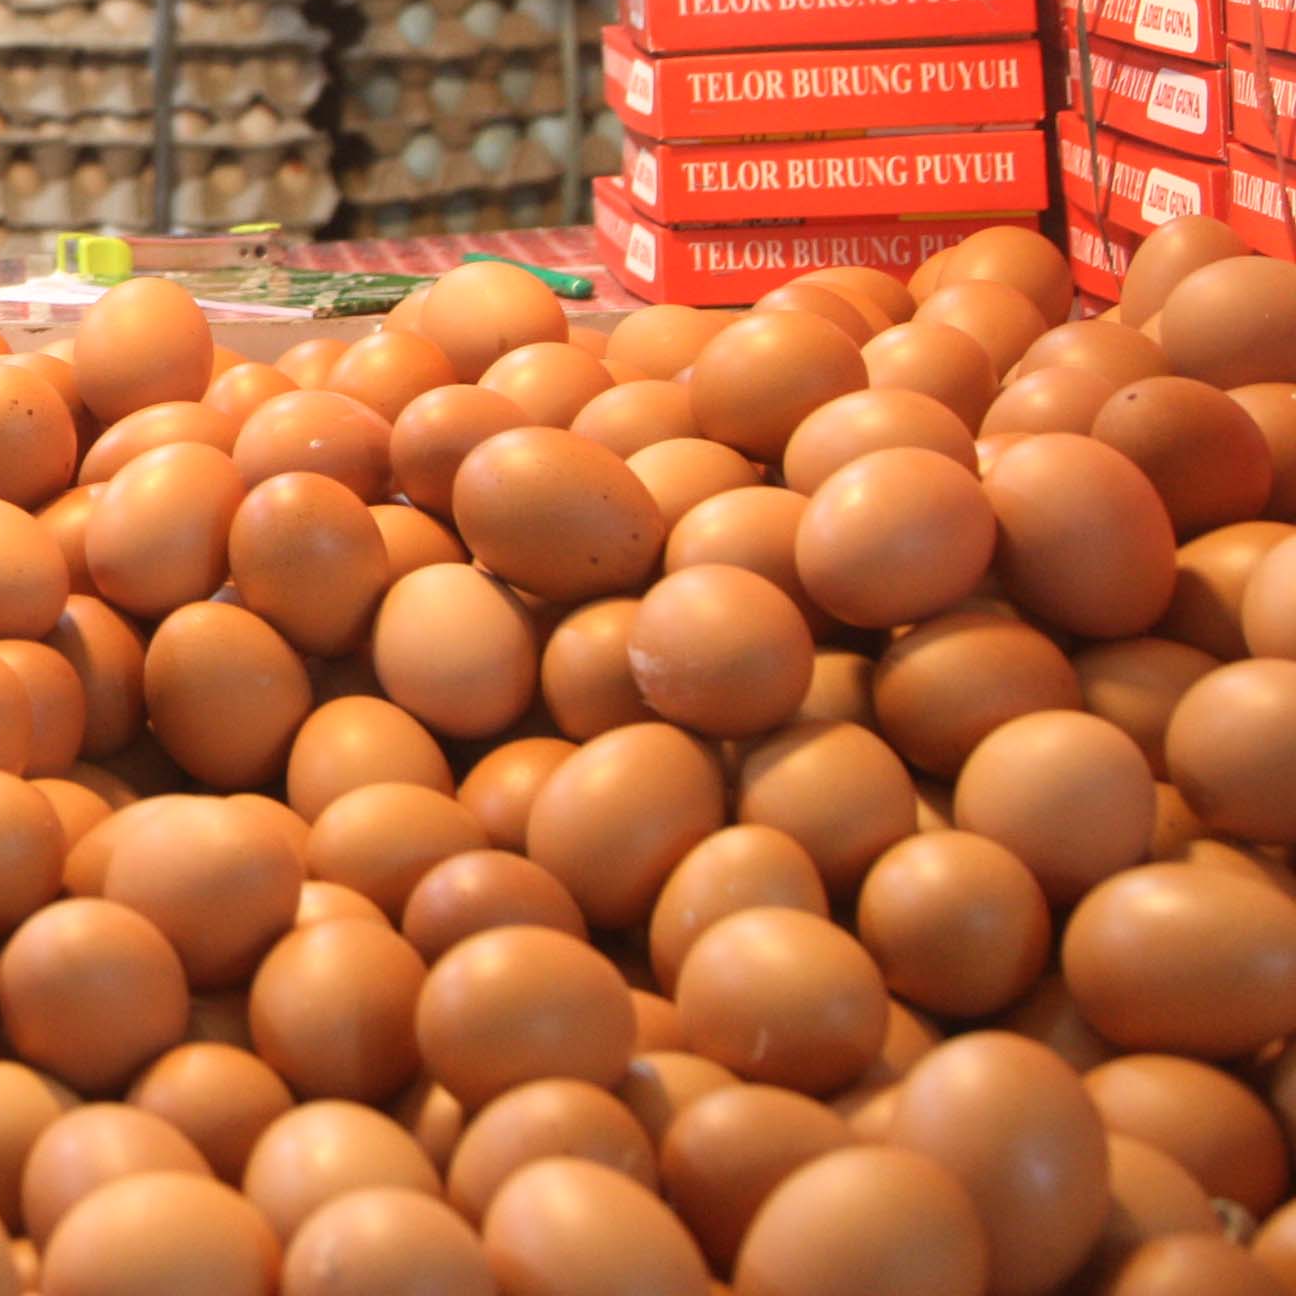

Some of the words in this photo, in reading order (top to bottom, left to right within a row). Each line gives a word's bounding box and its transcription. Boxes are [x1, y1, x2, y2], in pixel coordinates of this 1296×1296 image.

[687, 69, 785, 103] TELOR
[791, 63, 912, 99] BURUNG
[919, 58, 1019, 93] PUYUH
[681, 160, 781, 192] TELOR
[787, 155, 908, 189] BURUNG
[915, 152, 1015, 185] PUYUH
[688, 241, 787, 272] TELOR
[792, 235, 911, 268] BURUNG
